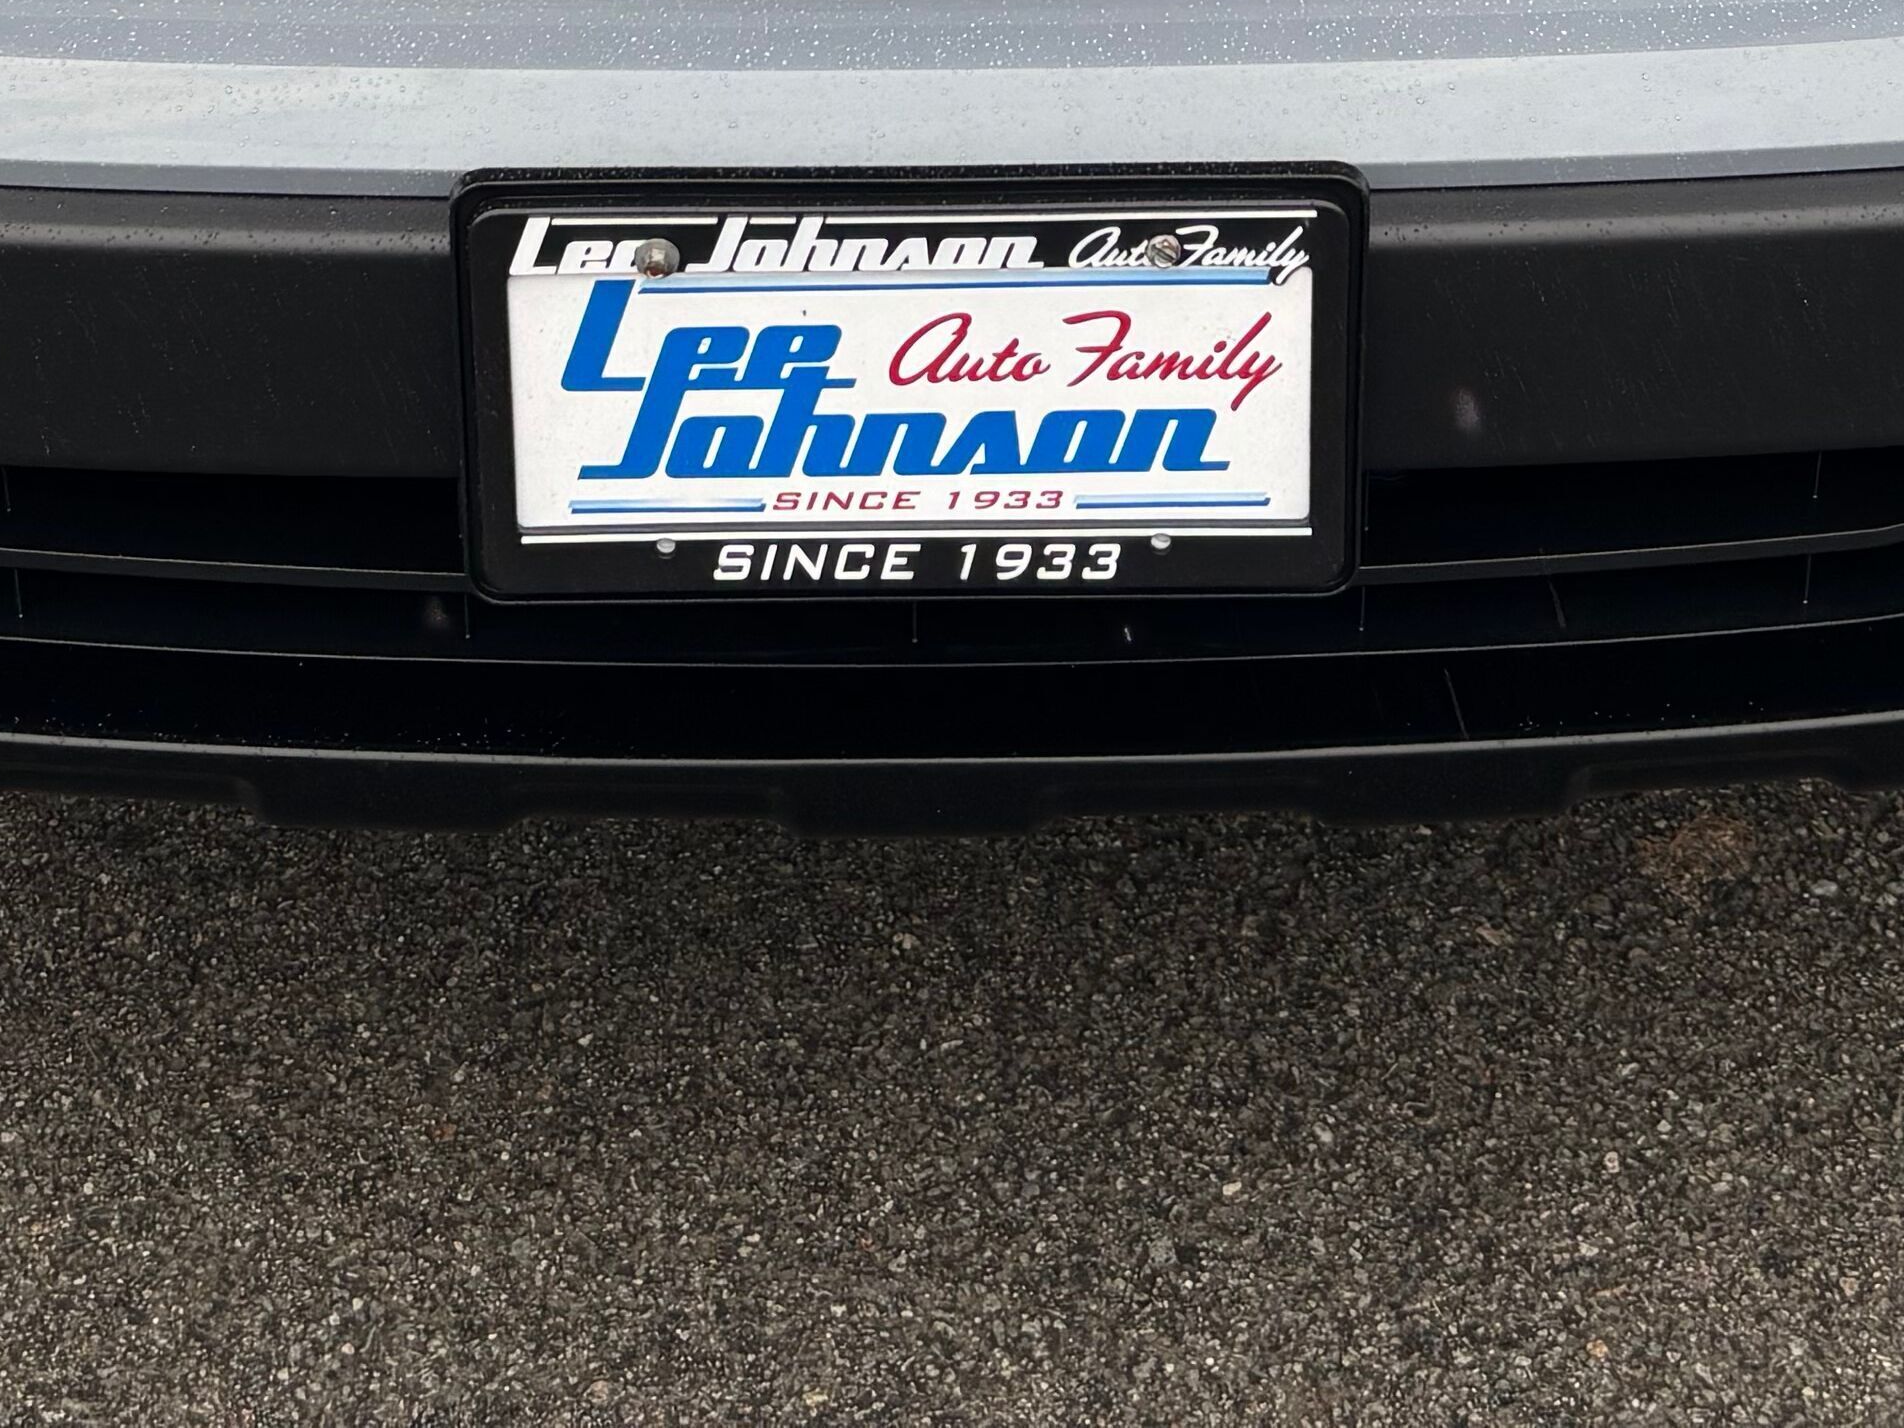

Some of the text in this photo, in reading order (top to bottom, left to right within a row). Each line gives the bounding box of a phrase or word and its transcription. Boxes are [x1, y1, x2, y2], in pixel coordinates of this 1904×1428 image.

[685, 215, 1045, 274] Johnson
[1068, 226, 1152, 269] Aut
[1176, 225, 1310, 285] Family
[561, 279, 858, 392] Lee
[888, 310, 1283, 411] Auto Family
[578, 366, 1231, 480] Johnson
[773, 490, 1064, 511] SINCE 1933
[713, 543, 1122, 582] SINCE 1933
